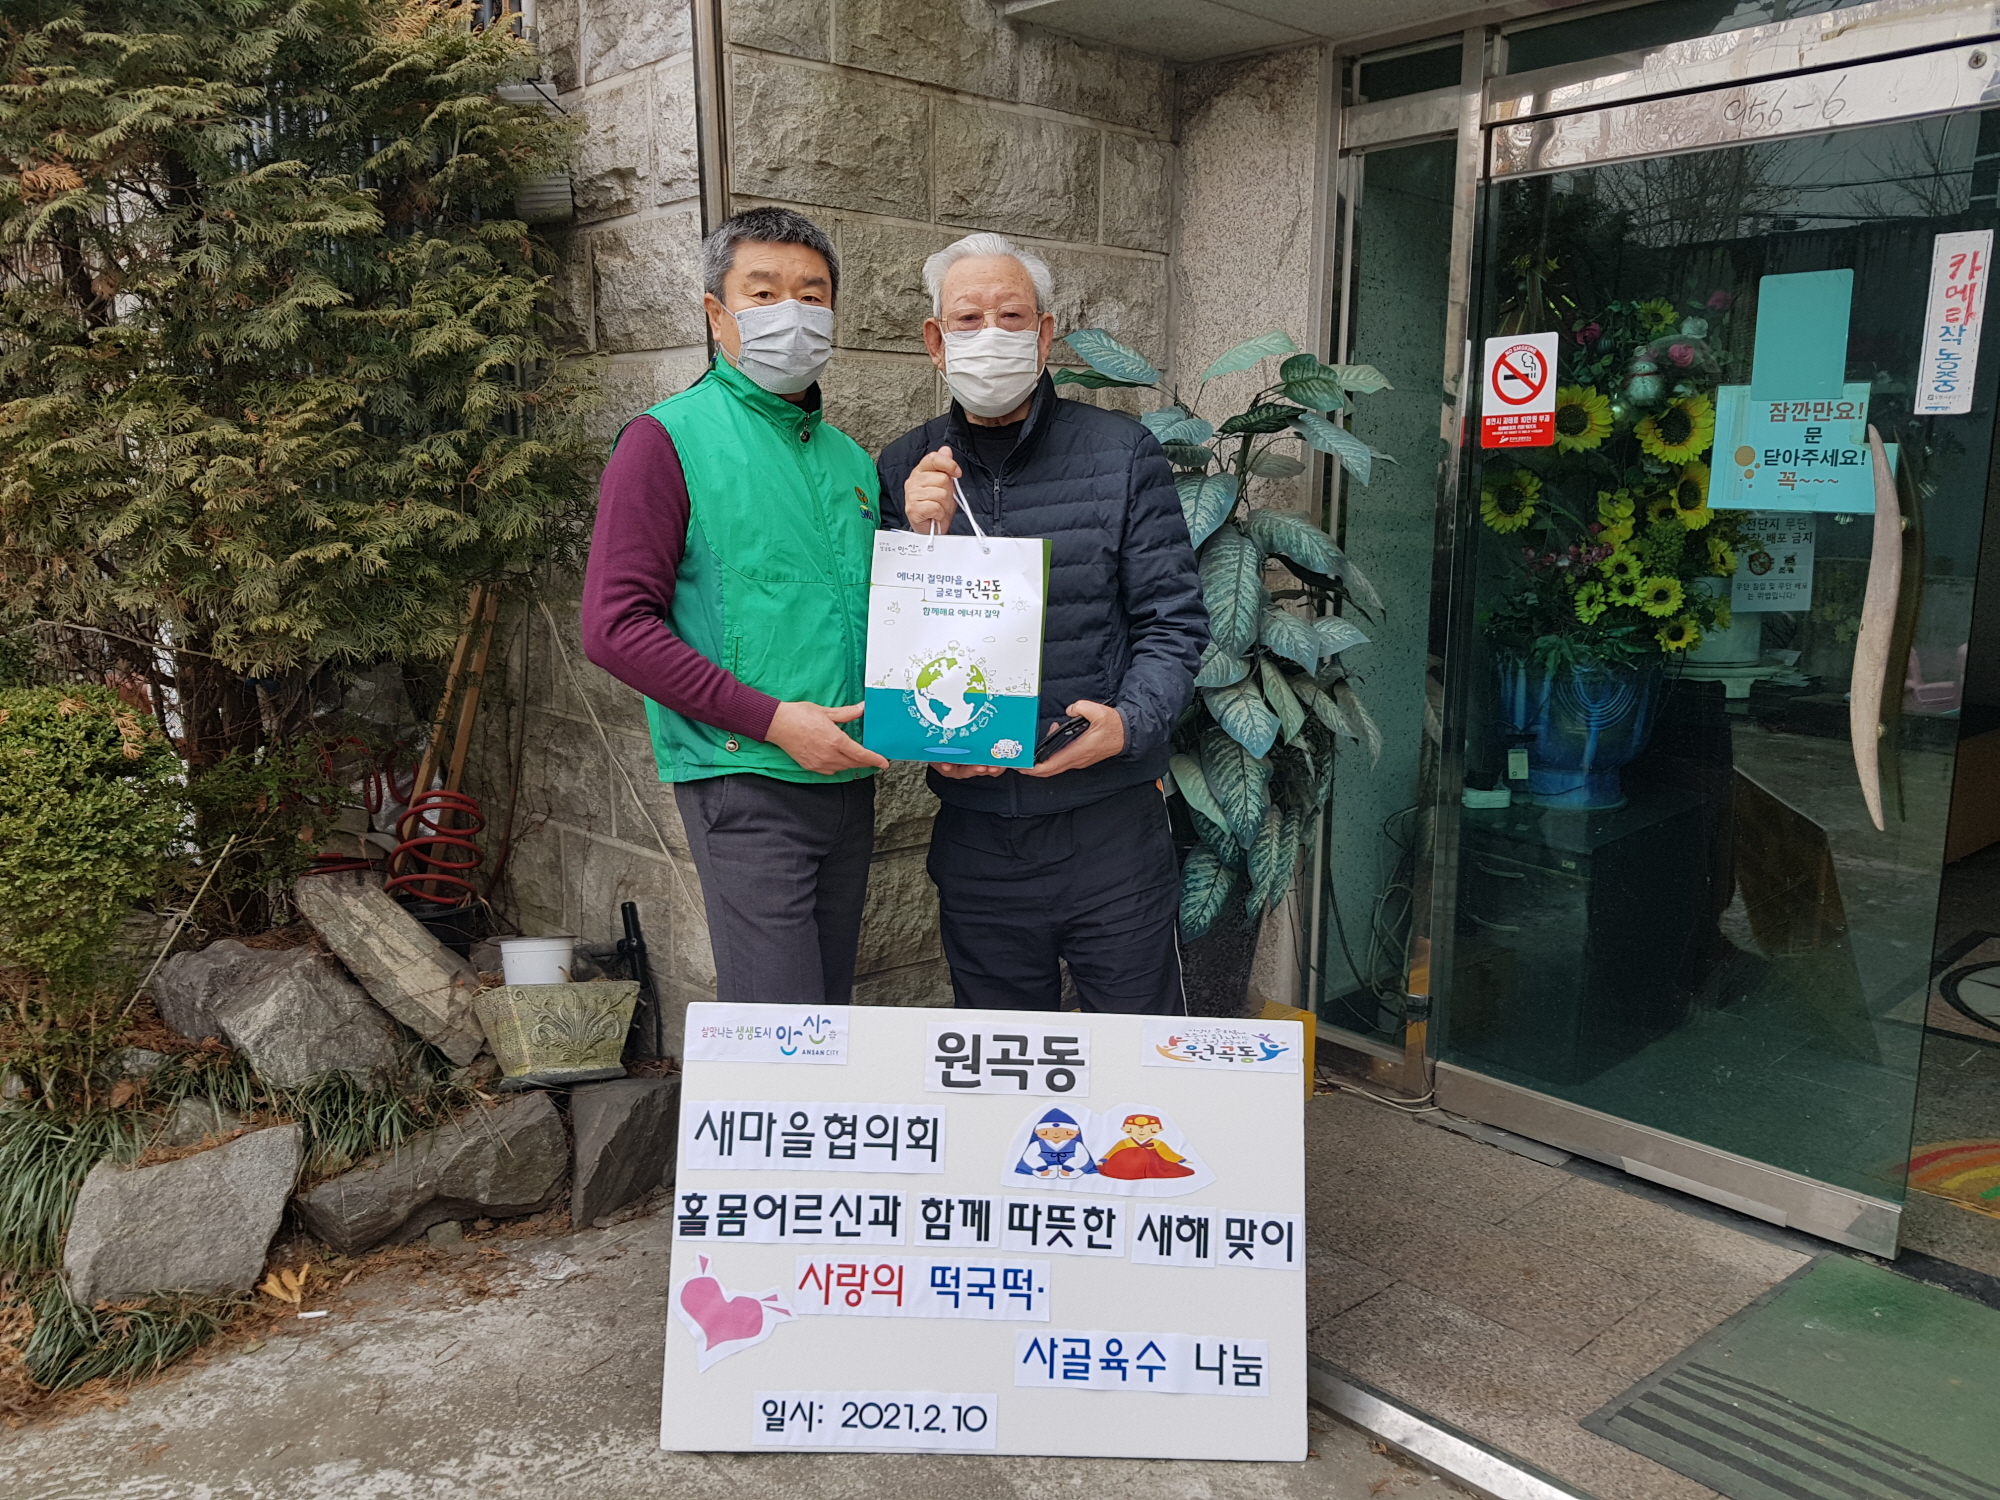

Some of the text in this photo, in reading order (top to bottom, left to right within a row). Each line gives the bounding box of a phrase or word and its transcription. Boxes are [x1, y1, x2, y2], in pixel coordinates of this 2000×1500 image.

[1723, 74, 1848, 138] 956-6
[1944, 250, 1983, 326] 카메라
[1504, 345, 1538, 356] NO SMOKING
[1932, 324, 1967, 394] 작동중
[1769, 401, 1864, 423] 잠깐만요!
[1803, 427, 1823, 444] 문
[1763, 449, 1866, 467] 닫아주세요!
[1745, 517, 1807, 531] 전단지 무단
[1792, 531, 1813, 544] 금지
[896, 572, 963, 585] 에너지 절약마을
[936, 579, 1002, 600] 글로벌 원곡동
[922, 606, 1000, 618] 함께해요 에너지 절약
[701, 1026, 734, 1039] 살맛나는
[735, 1025, 772, 1041] 생생도시
[934, 1033, 1086, 1092] 원곡동
[1183, 1044, 1258, 1064] 원곡동
[693, 1109, 940, 1163] 새마을협의회
[677, 1192, 1294, 1263] 홀몸어르신과 함께 따뜻한 새해 맞이
[798, 1262, 904, 1308] 사랑의
[1022, 1336, 1263, 1387] 사골육수 나눔
[761, 1400, 988, 1434] 일시: 2021.2.10
